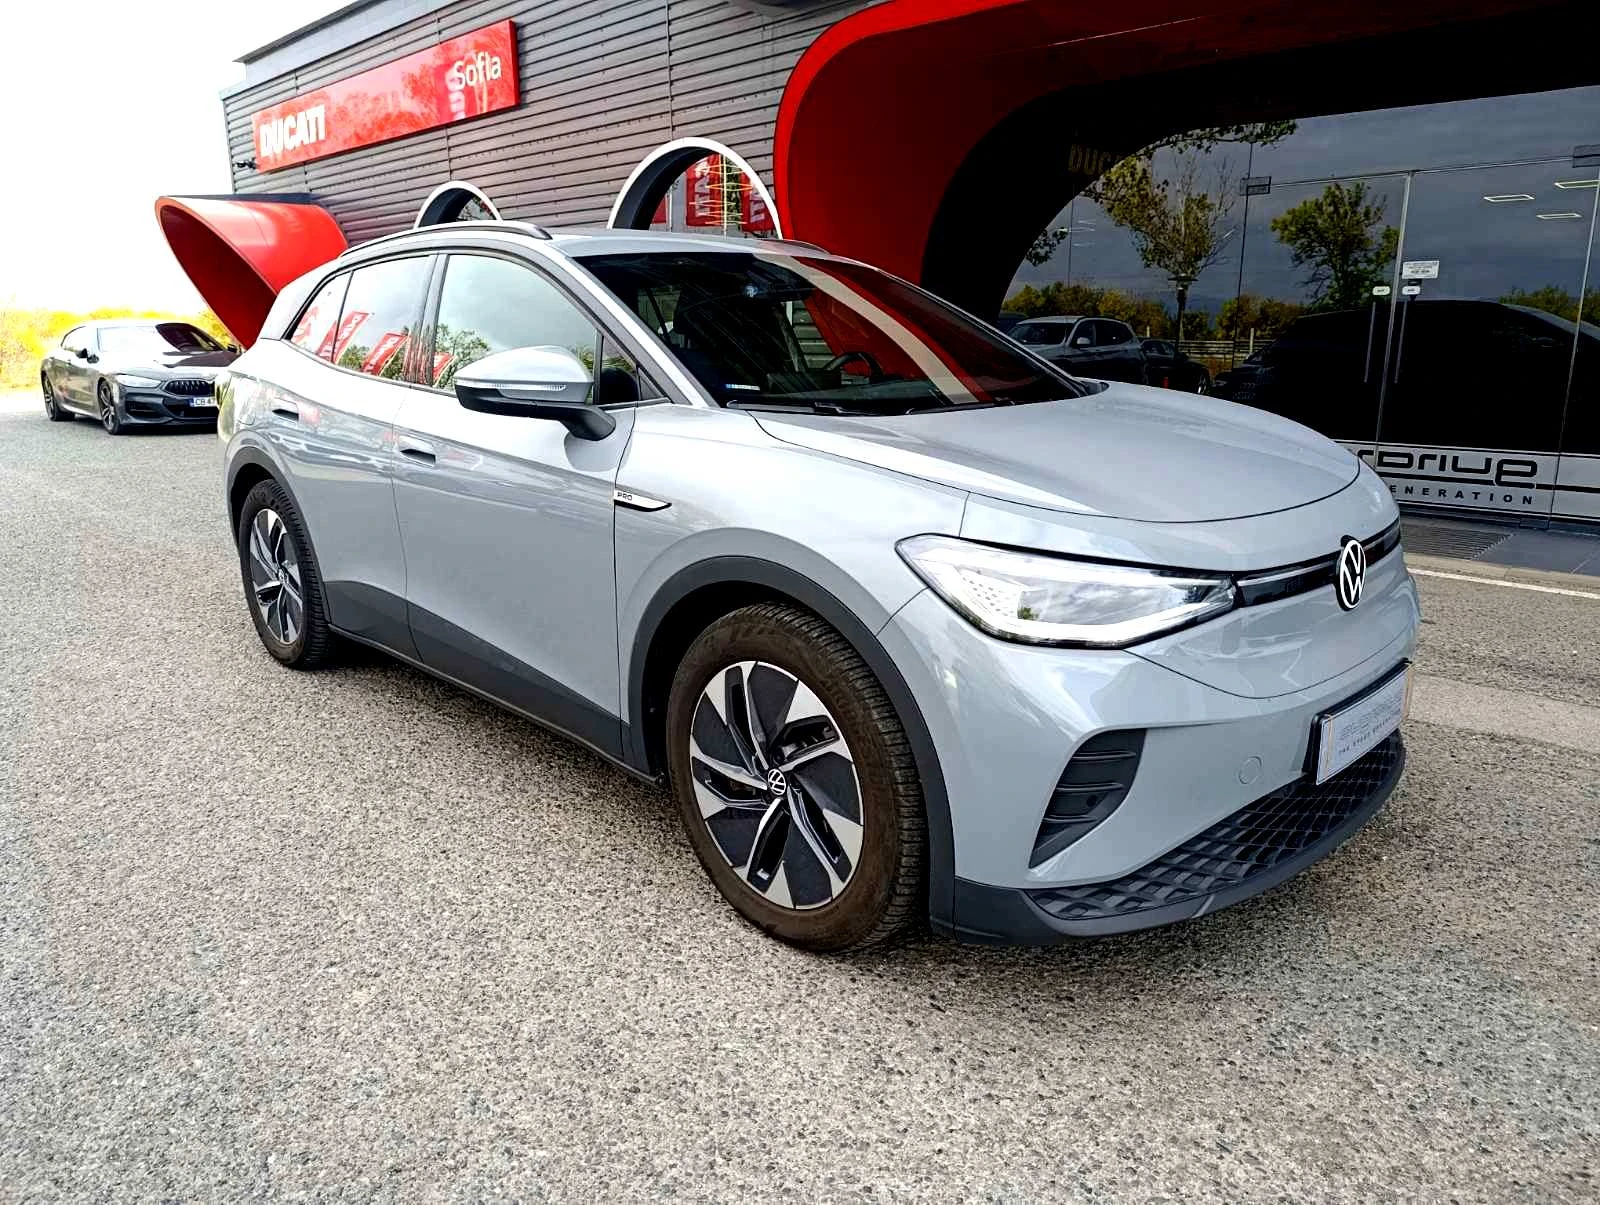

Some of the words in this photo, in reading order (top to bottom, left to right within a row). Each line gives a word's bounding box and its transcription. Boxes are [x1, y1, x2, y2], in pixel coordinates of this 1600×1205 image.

[259, 104, 326, 157] DUCATI
[453, 51, 502, 92] Sofia
[617, 491, 633, 501] PRO
[1389, 484, 1533, 505] ENERATION
